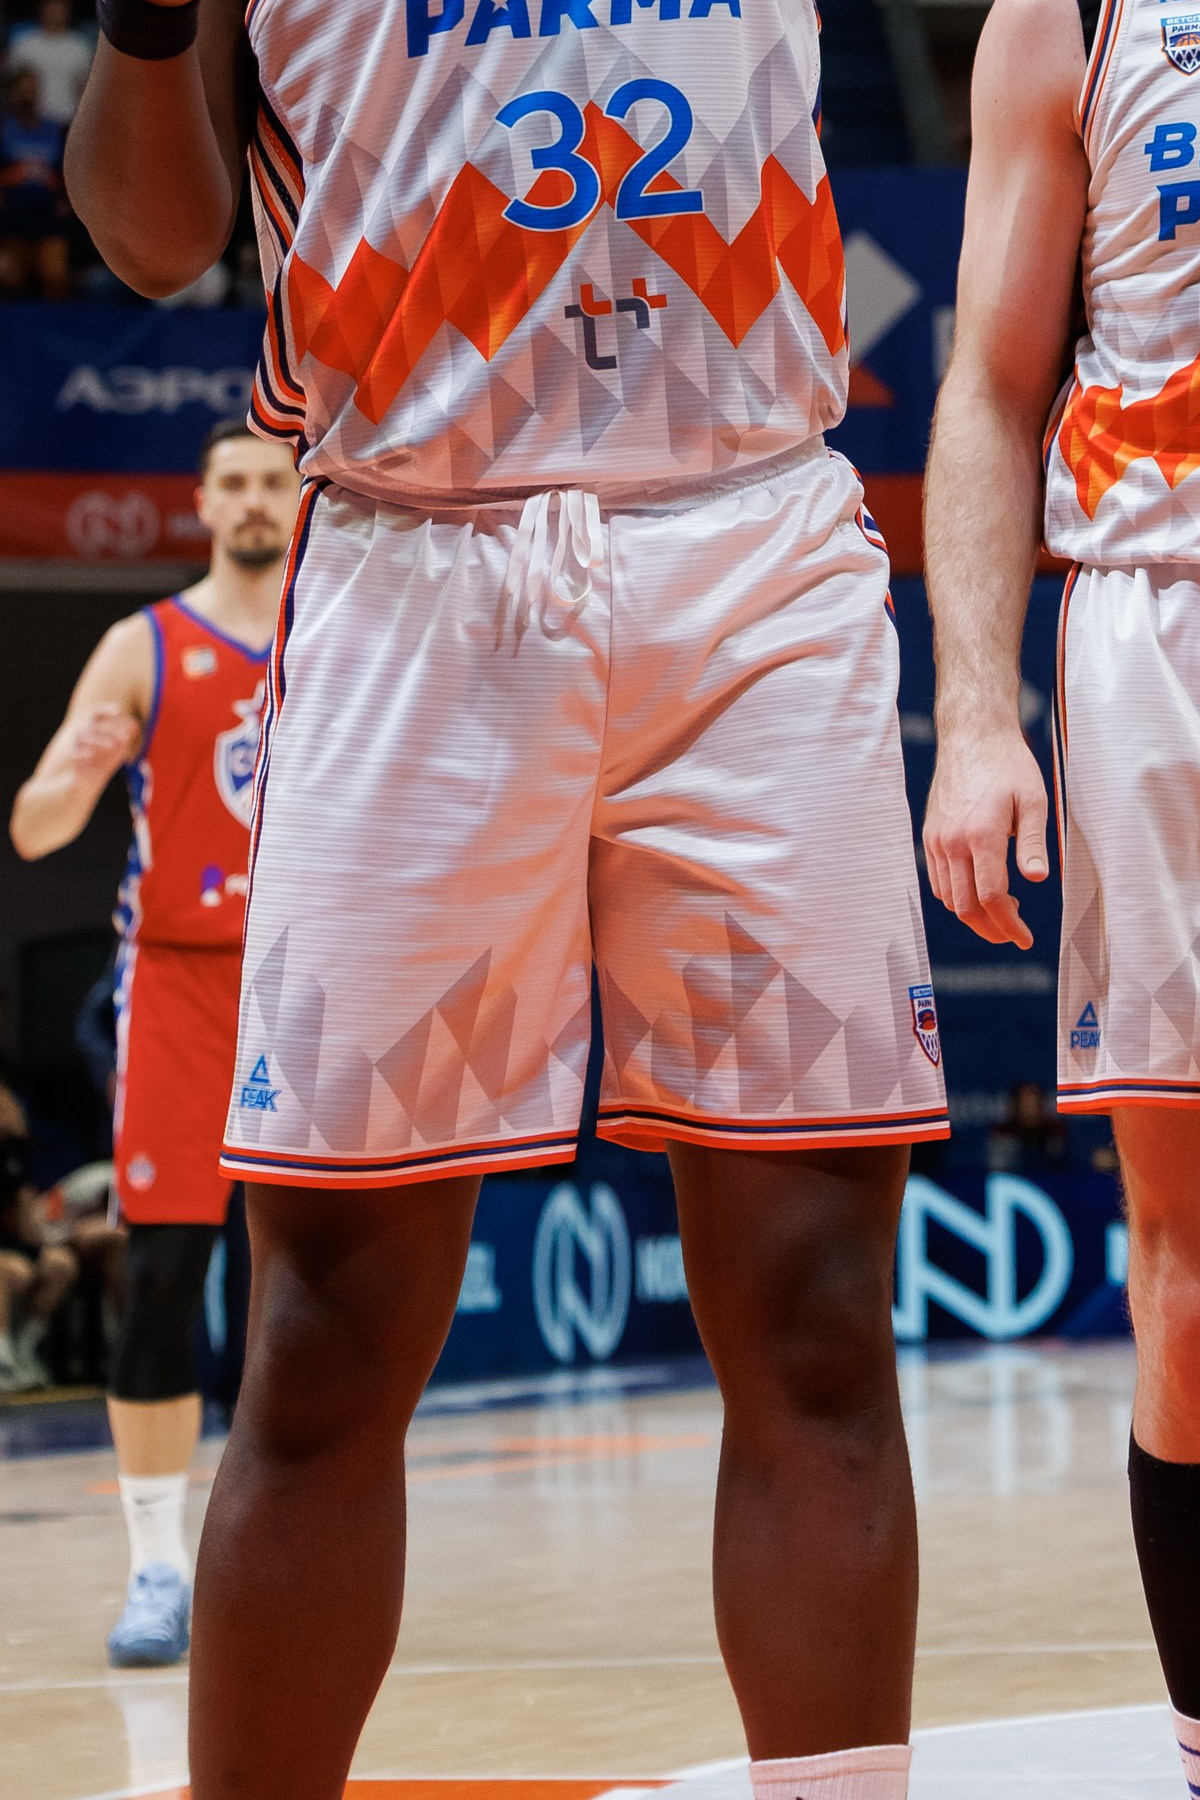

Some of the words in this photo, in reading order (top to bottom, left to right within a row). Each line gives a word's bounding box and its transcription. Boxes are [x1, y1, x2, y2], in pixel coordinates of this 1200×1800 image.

[494, 77, 704, 233] 32
[57, 363, 258, 415] АЭРО
[240, 1085, 282, 1113] PEAK
